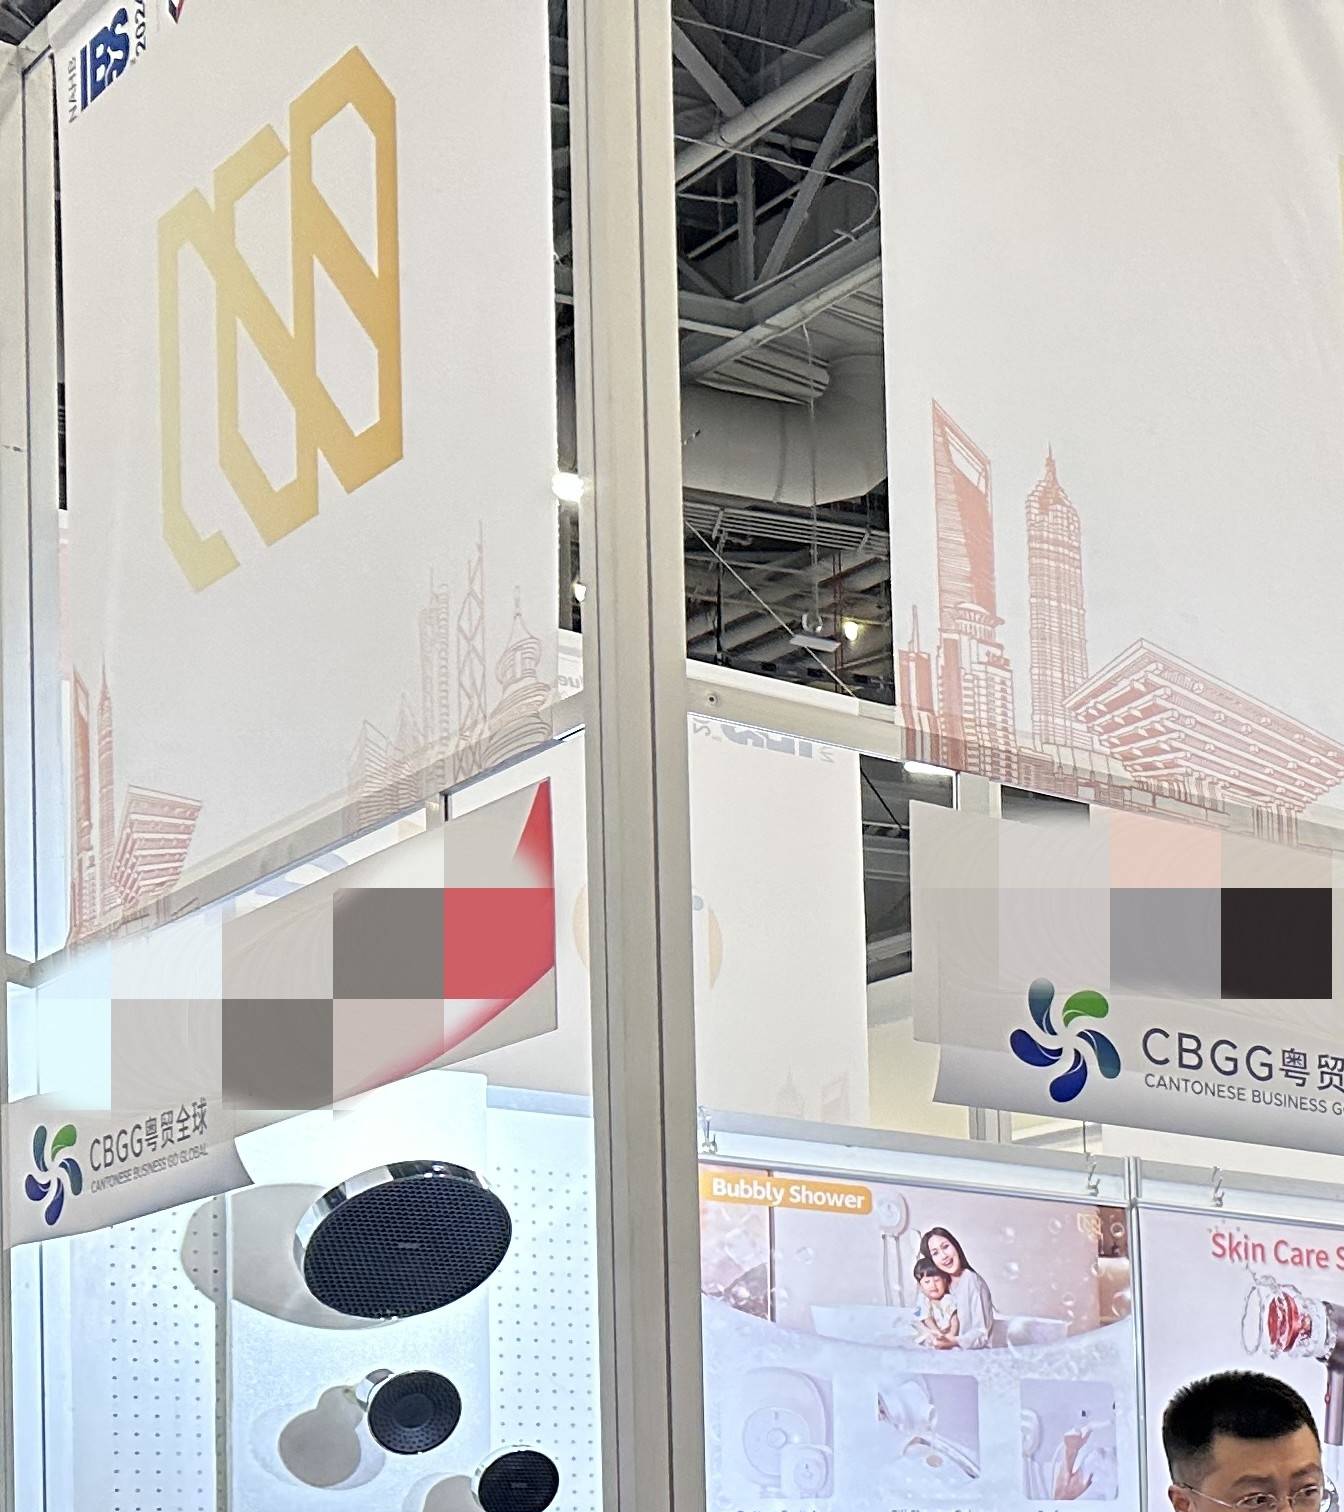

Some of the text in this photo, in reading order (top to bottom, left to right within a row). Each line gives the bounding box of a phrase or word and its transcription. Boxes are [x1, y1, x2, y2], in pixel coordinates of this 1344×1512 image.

[80, 7, 131, 112] IBS
[1144, 1072, 1247, 1102] CANTONESE
[1251, 1089, 1328, 1114] BUSINESS
[711, 1177, 866, 1210] Bubbly Shower
[1210, 1231, 1267, 1264] Skin
[1273, 1239, 1330, 1269] Care
